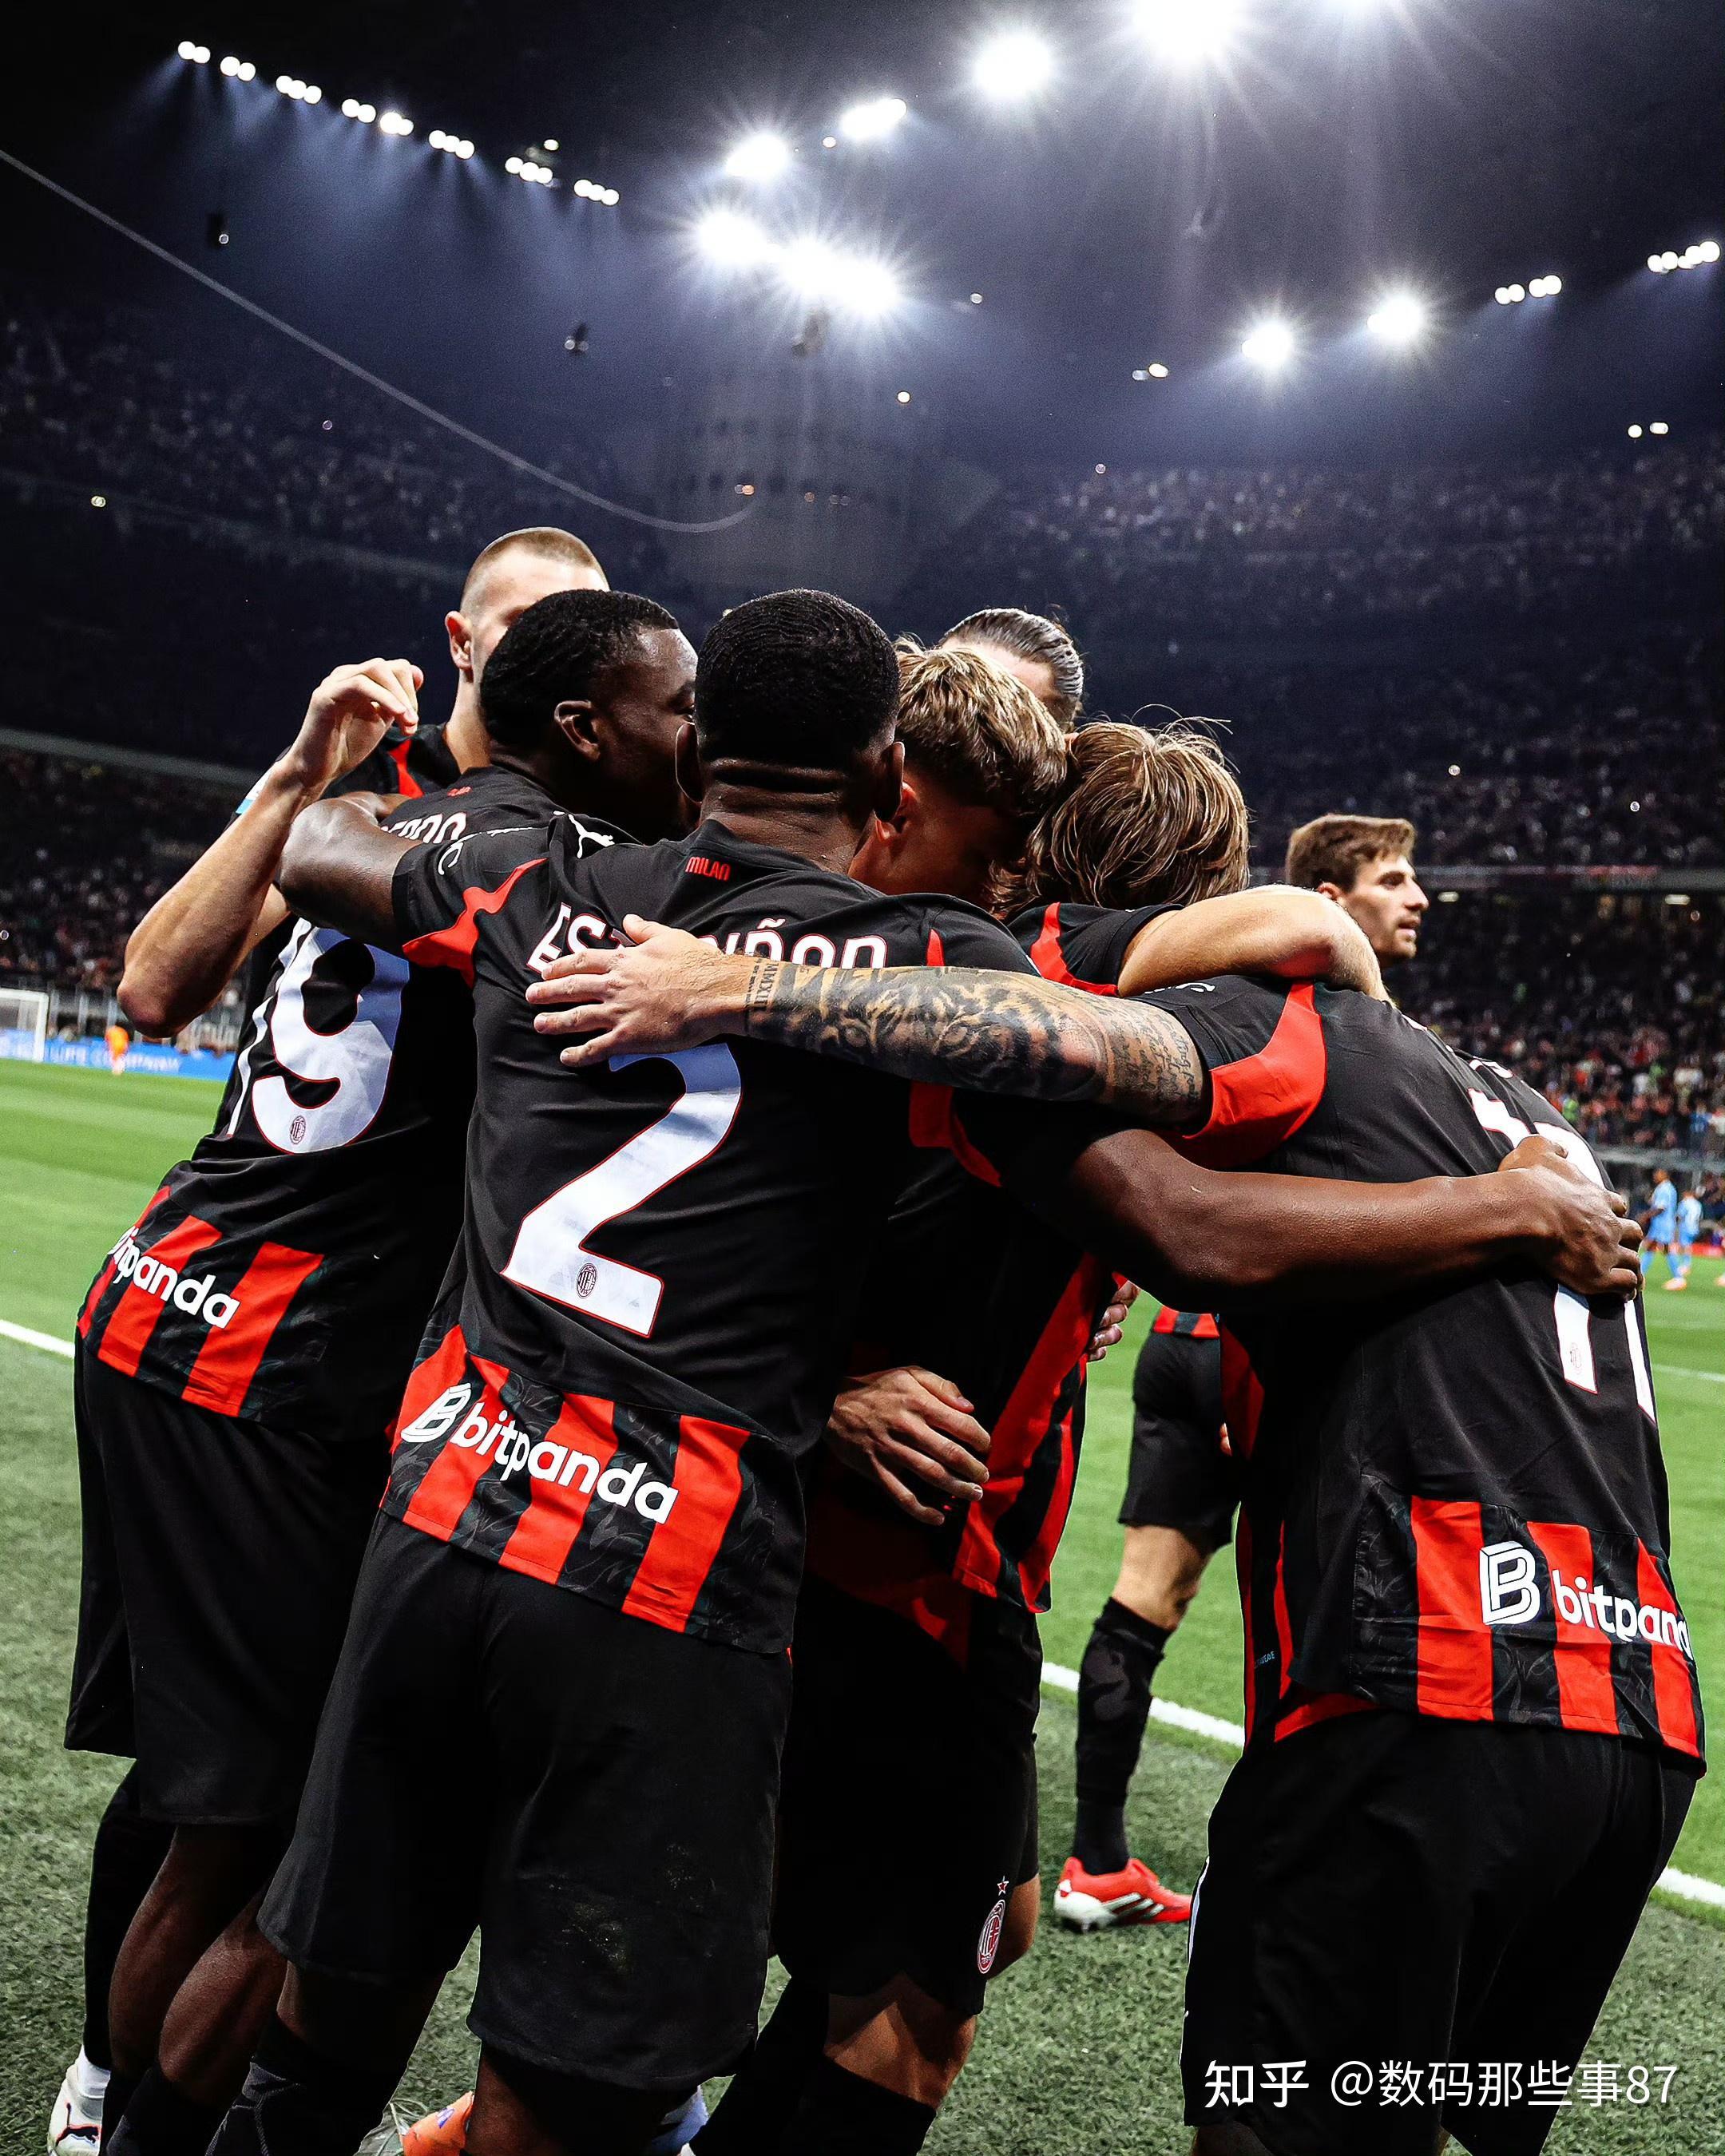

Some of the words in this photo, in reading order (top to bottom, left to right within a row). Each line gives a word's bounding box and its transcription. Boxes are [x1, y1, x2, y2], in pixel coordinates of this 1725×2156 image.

[684, 856, 731, 881] MILAN
[499, 1041, 743, 1339] 2
[450, 1401, 680, 1524] bitpanda
[1552, 1569, 1694, 1661] bitpand
